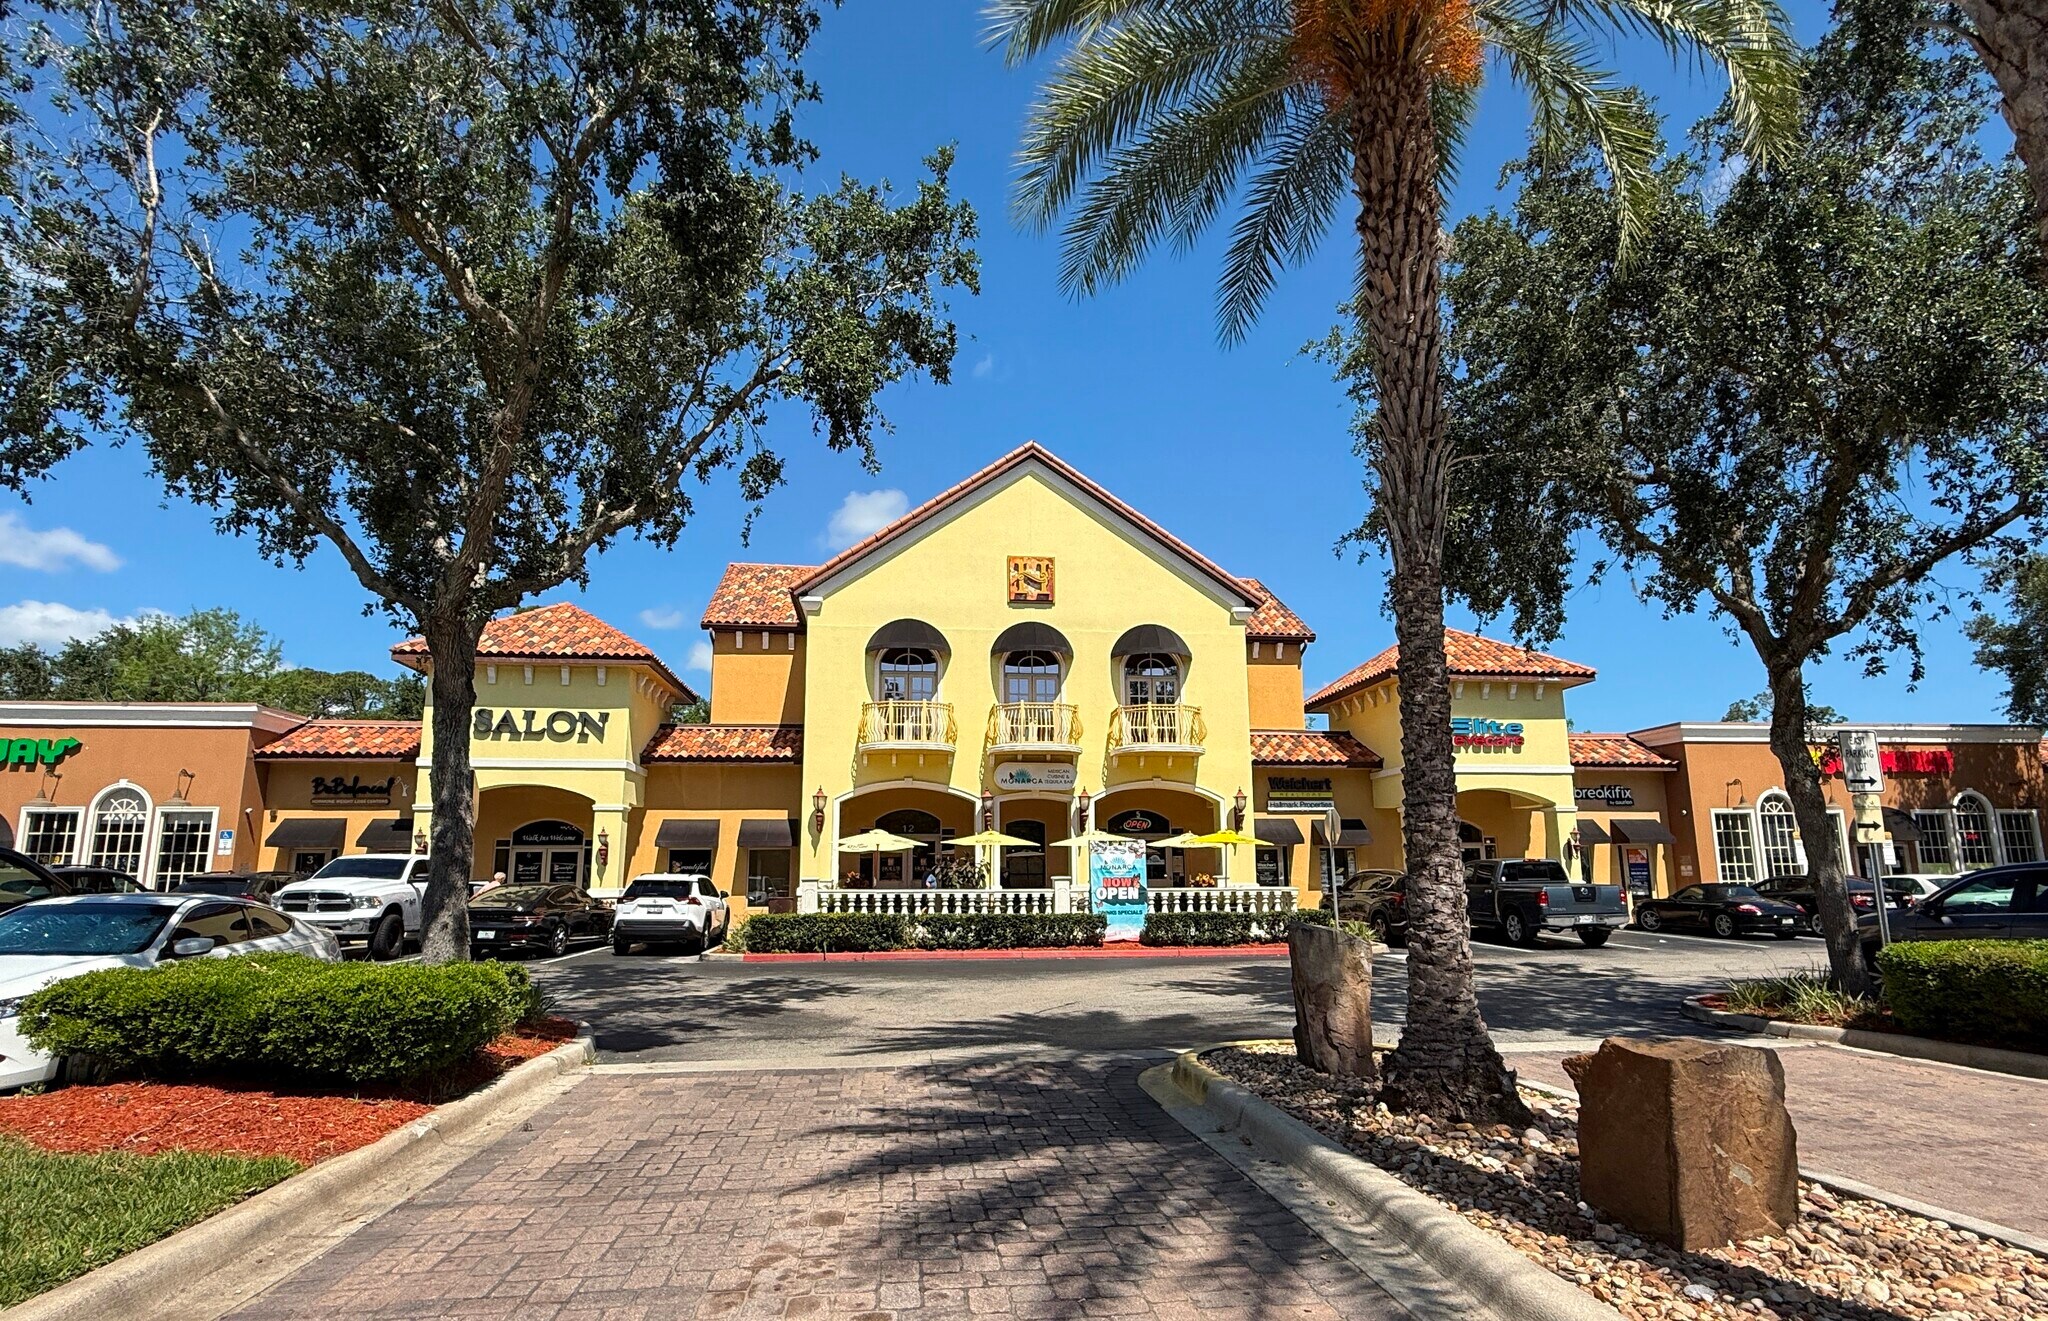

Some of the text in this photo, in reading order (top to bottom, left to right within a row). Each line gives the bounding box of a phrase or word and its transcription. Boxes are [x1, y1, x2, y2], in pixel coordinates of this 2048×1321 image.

[473, 708, 610, 743] SALON
[1451, 718, 1524, 735] Elite
[1454, 735, 1525, 747] eyecare
[1848, 736, 1865, 745] EAST
[1845, 749, 1874, 759] PARKING
[1855, 762, 1867, 772] LOT
[1574, 786, 1632, 799] breakifix
[902, 824, 915, 833] 12
[1125, 820, 1149, 829] OPEN
[522, 834, 539, 842] Walk
[306, 855, 314, 864] 3
[1263, 853, 1269, 861] 6
[1102, 877, 1132, 887] NOW
[1095, 887, 1139, 900] OPEN
